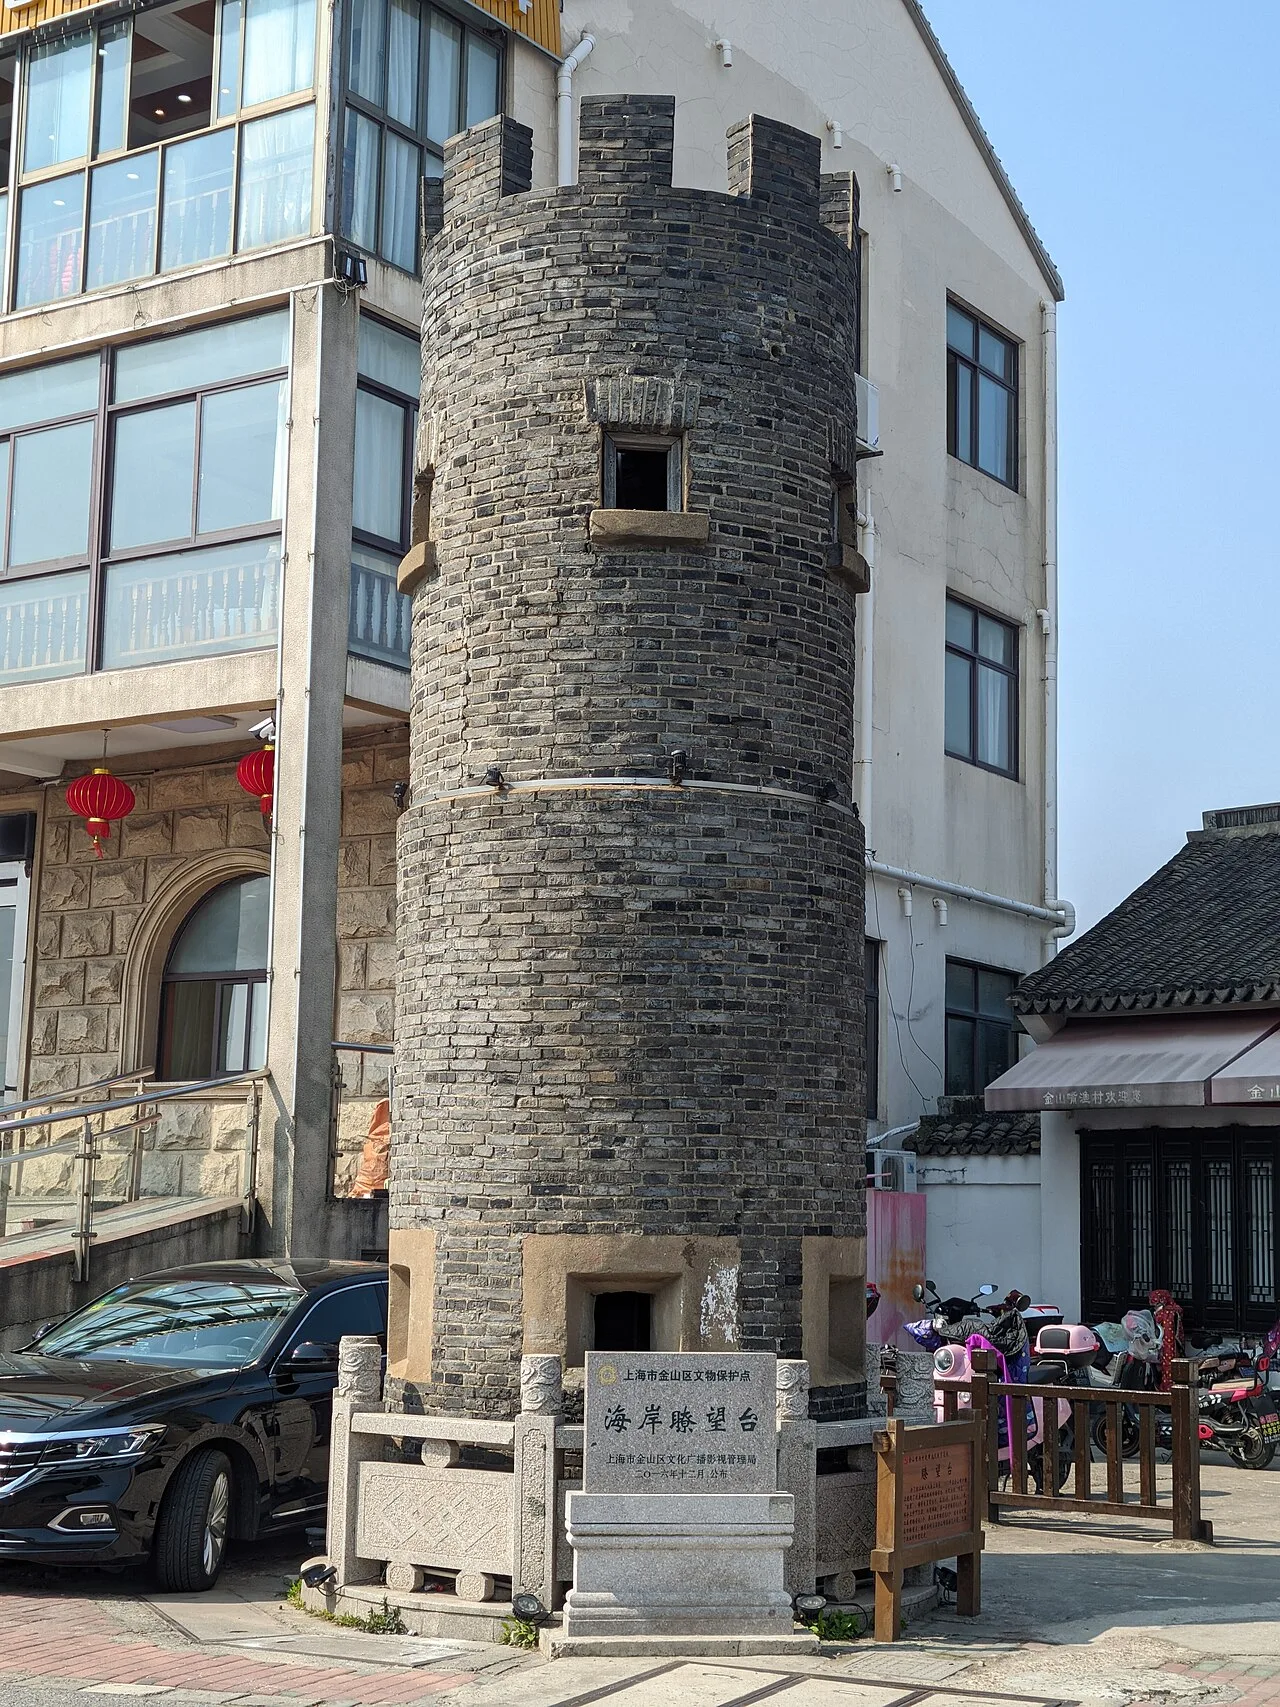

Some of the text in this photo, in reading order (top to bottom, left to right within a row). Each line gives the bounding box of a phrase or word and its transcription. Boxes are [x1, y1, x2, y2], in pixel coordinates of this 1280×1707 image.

[623, 1369, 751, 1382] 上海市金山区文物保护点
[604, 1403, 758, 1435] 海岸瞭望台
[605, 1454, 757, 1465] 上海市金山区文化广播影视管理局
